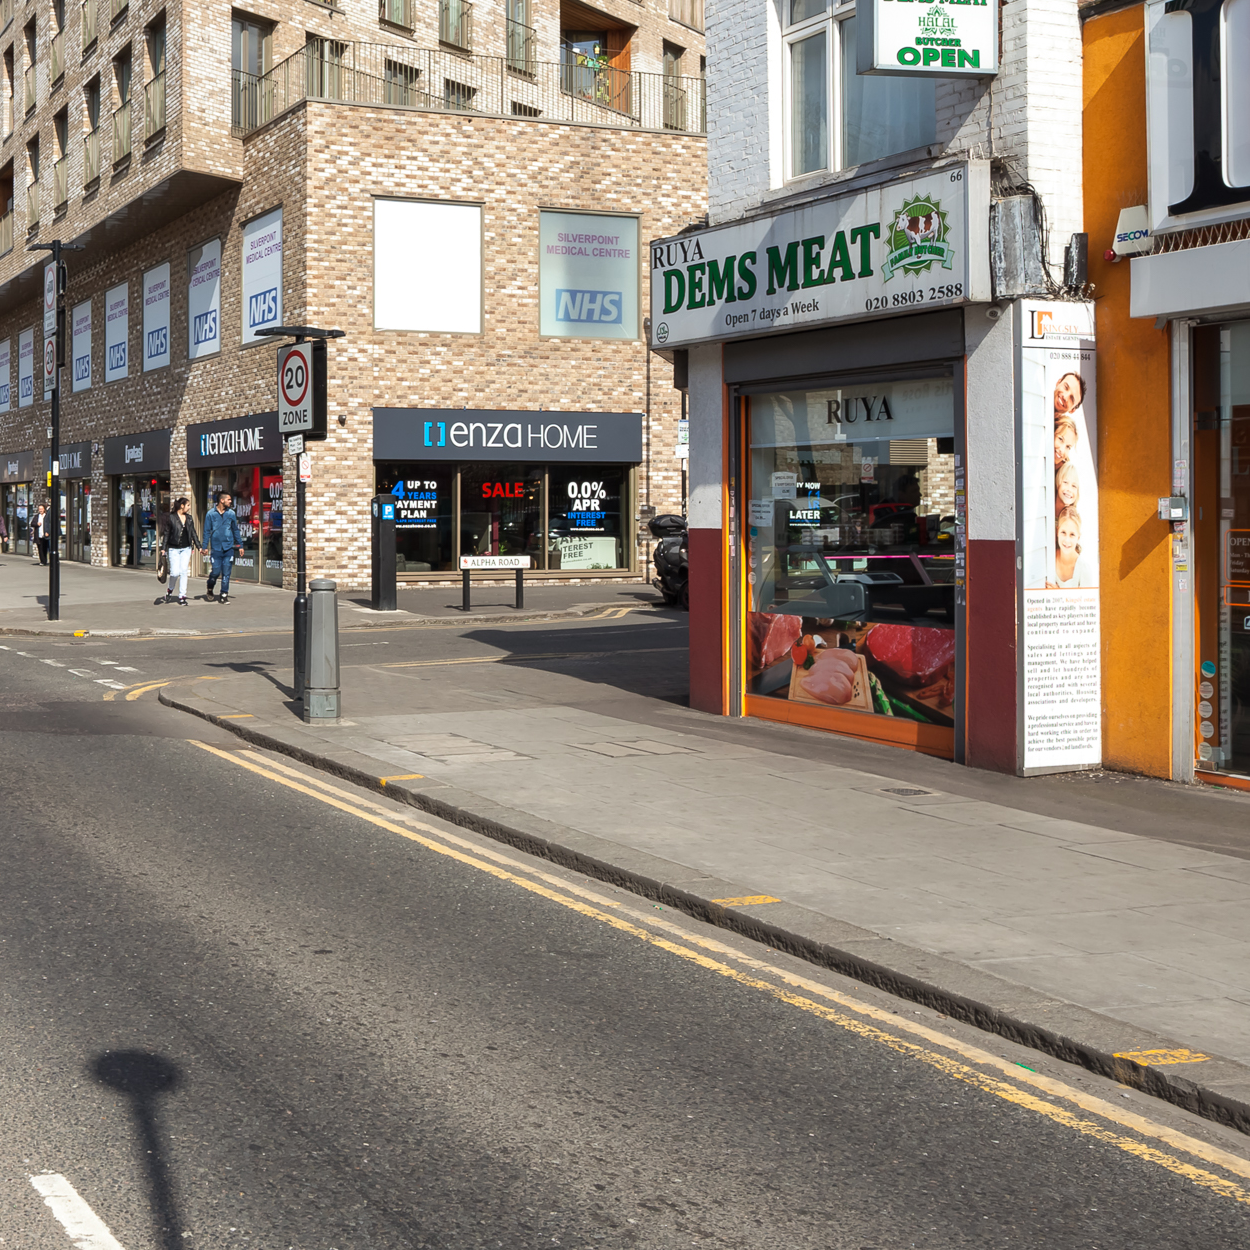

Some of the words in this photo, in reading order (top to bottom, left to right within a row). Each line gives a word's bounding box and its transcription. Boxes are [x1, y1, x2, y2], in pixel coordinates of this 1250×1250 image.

[918, 17, 958, 28] HALAL
[915, 37, 961, 47] BUTCHER
[896, 47, 980, 68] OPEN
[950, 169, 963, 183] 66
[251, 230, 276, 250] SILVERPOINT
[557, 233, 619, 246] SILVERPOINT
[1117, 229, 1148, 242] SECOM
[246, 251, 264, 264] MEDICAL
[264, 242, 281, 258] CENTRE
[546, 245, 590, 256] MEDICAL
[592, 247, 630, 259] CENTRE
[652, 237, 704, 270] RUYA
[890, 247, 913, 268] FAMILY
[915, 244, 945, 258] BUTCHER
[663, 251, 757, 314] DEMS
[766, 222, 881, 296] MEAT
[865, 297, 888, 312] 020
[892, 290, 924, 307] 8803
[929, 282, 963, 300] 2588
[251, 289, 277, 325] NHS
[557, 291, 620, 321] NHS
[725, 311, 749, 328] Open
[751, 309, 757, 321] 7
[759, 306, 781, 323] days
[782, 306, 788, 316] a
[791, 298, 819, 314] Week
[194, 311, 216, 343] NHS
[1043, 324, 1079, 333] KINGSLY
[148, 328, 167, 357] NHS
[110, 343, 126, 369] NHS
[1050, 352, 1060, 360] 020
[76, 356, 89, 380] NHS
[285, 365, 305, 390] 20
[283, 409, 308, 425] ZONE
[826, 395, 893, 425] RUYA
[209, 430, 234, 455] enza
[236, 427, 264, 452] HOME
[450, 422, 522, 447] enza
[528, 424, 598, 449] HOME
[391, 480, 405, 500] 4
[407, 481, 421, 489] UP
[424, 481, 437, 489] TO
[482, 482, 524, 498] SALE
[567, 481, 606, 499] 0.0%
[395, 500, 437, 509] AYMENT
[407, 492, 437, 500] YEARS
[572, 499, 600, 511] APR
[401, 510, 427, 518] PLAN
[567, 511, 606, 519] INTEREST
[789, 510, 821, 519] LATER
[576, 519, 596, 527] FREE
[499, 558, 520, 566] ROAD
[563, 551, 583, 559] FREE
